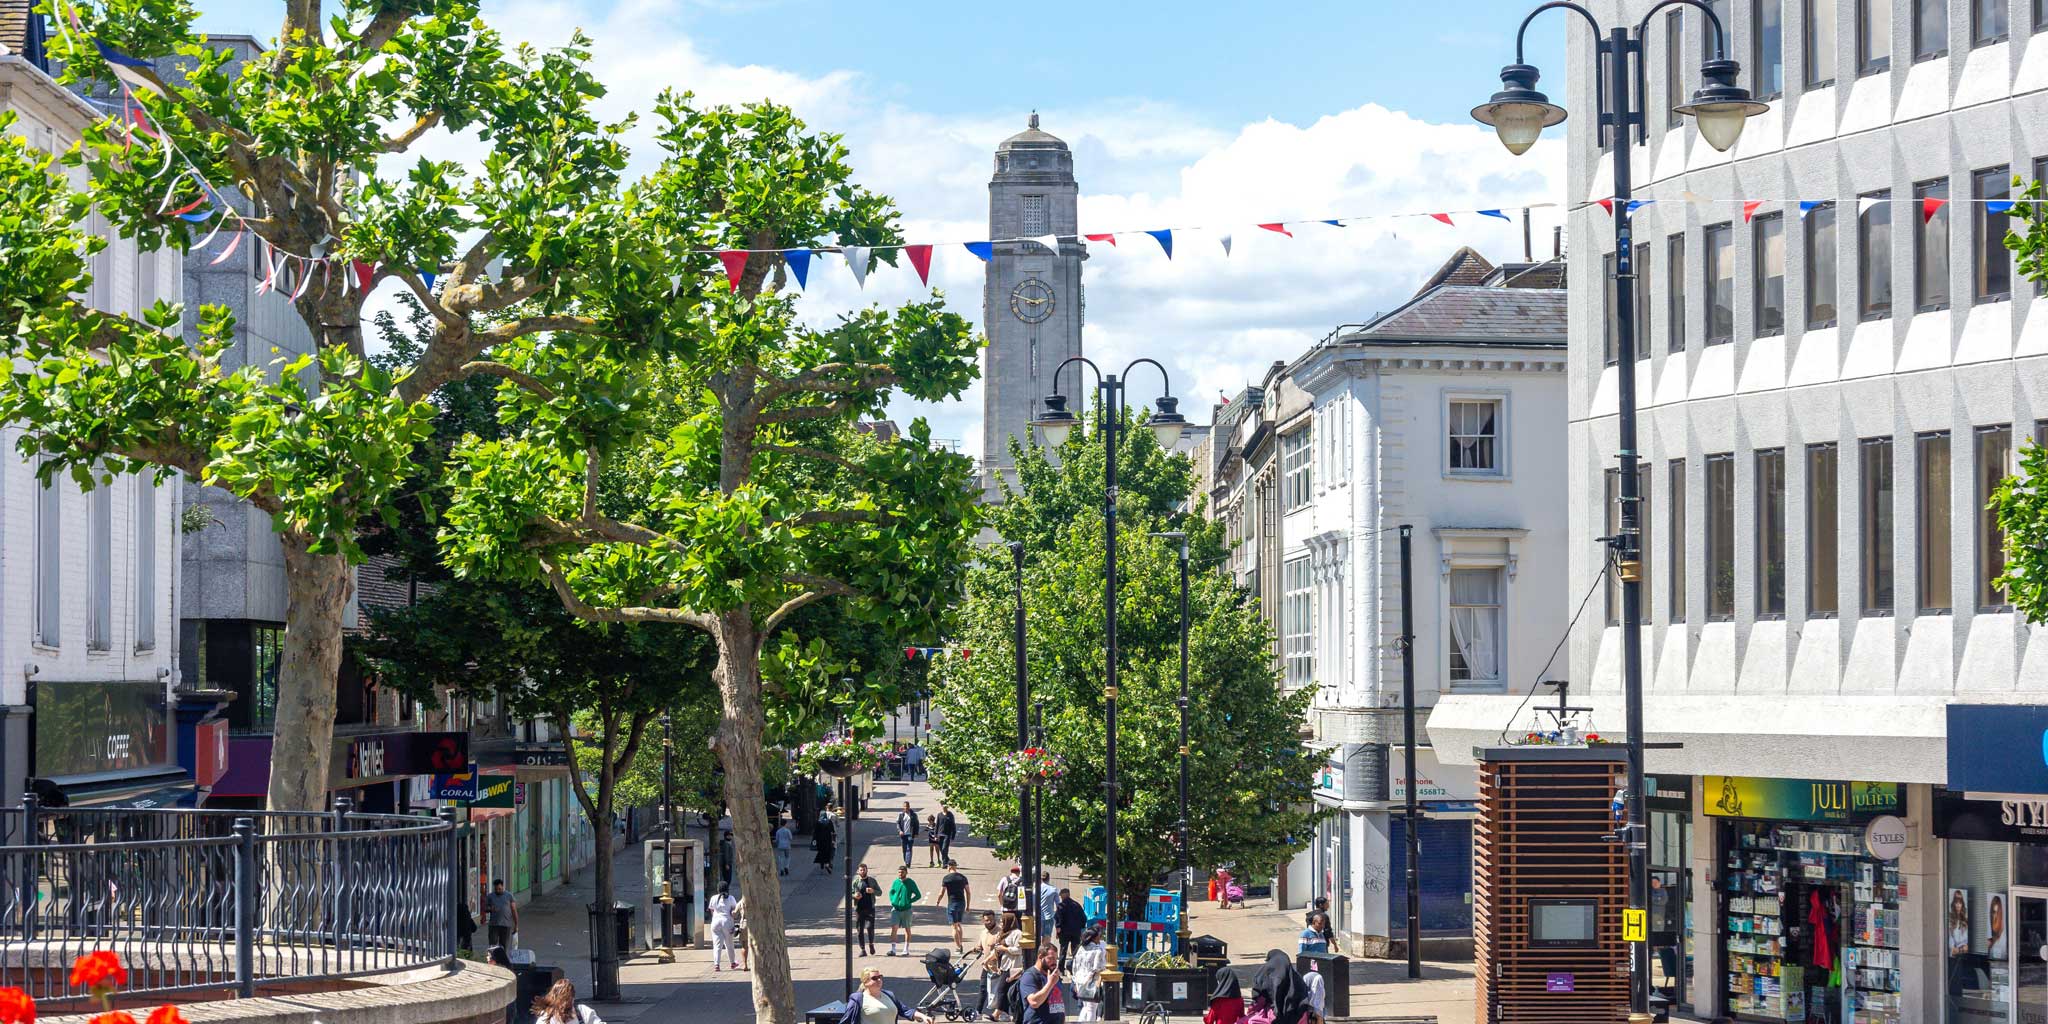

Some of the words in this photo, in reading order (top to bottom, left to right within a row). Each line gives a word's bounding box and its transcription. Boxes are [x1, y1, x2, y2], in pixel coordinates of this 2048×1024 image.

[107, 734, 130, 760] COFFEE
[359, 740, 385, 778] NatWest
[440, 789, 475, 798] CORAL
[470, 780, 512, 803] UBWAY
[1852, 793, 1897, 812] JULIETS
[1872, 832, 1905, 842] STYLES
[1626, 912, 1642, 937] H
